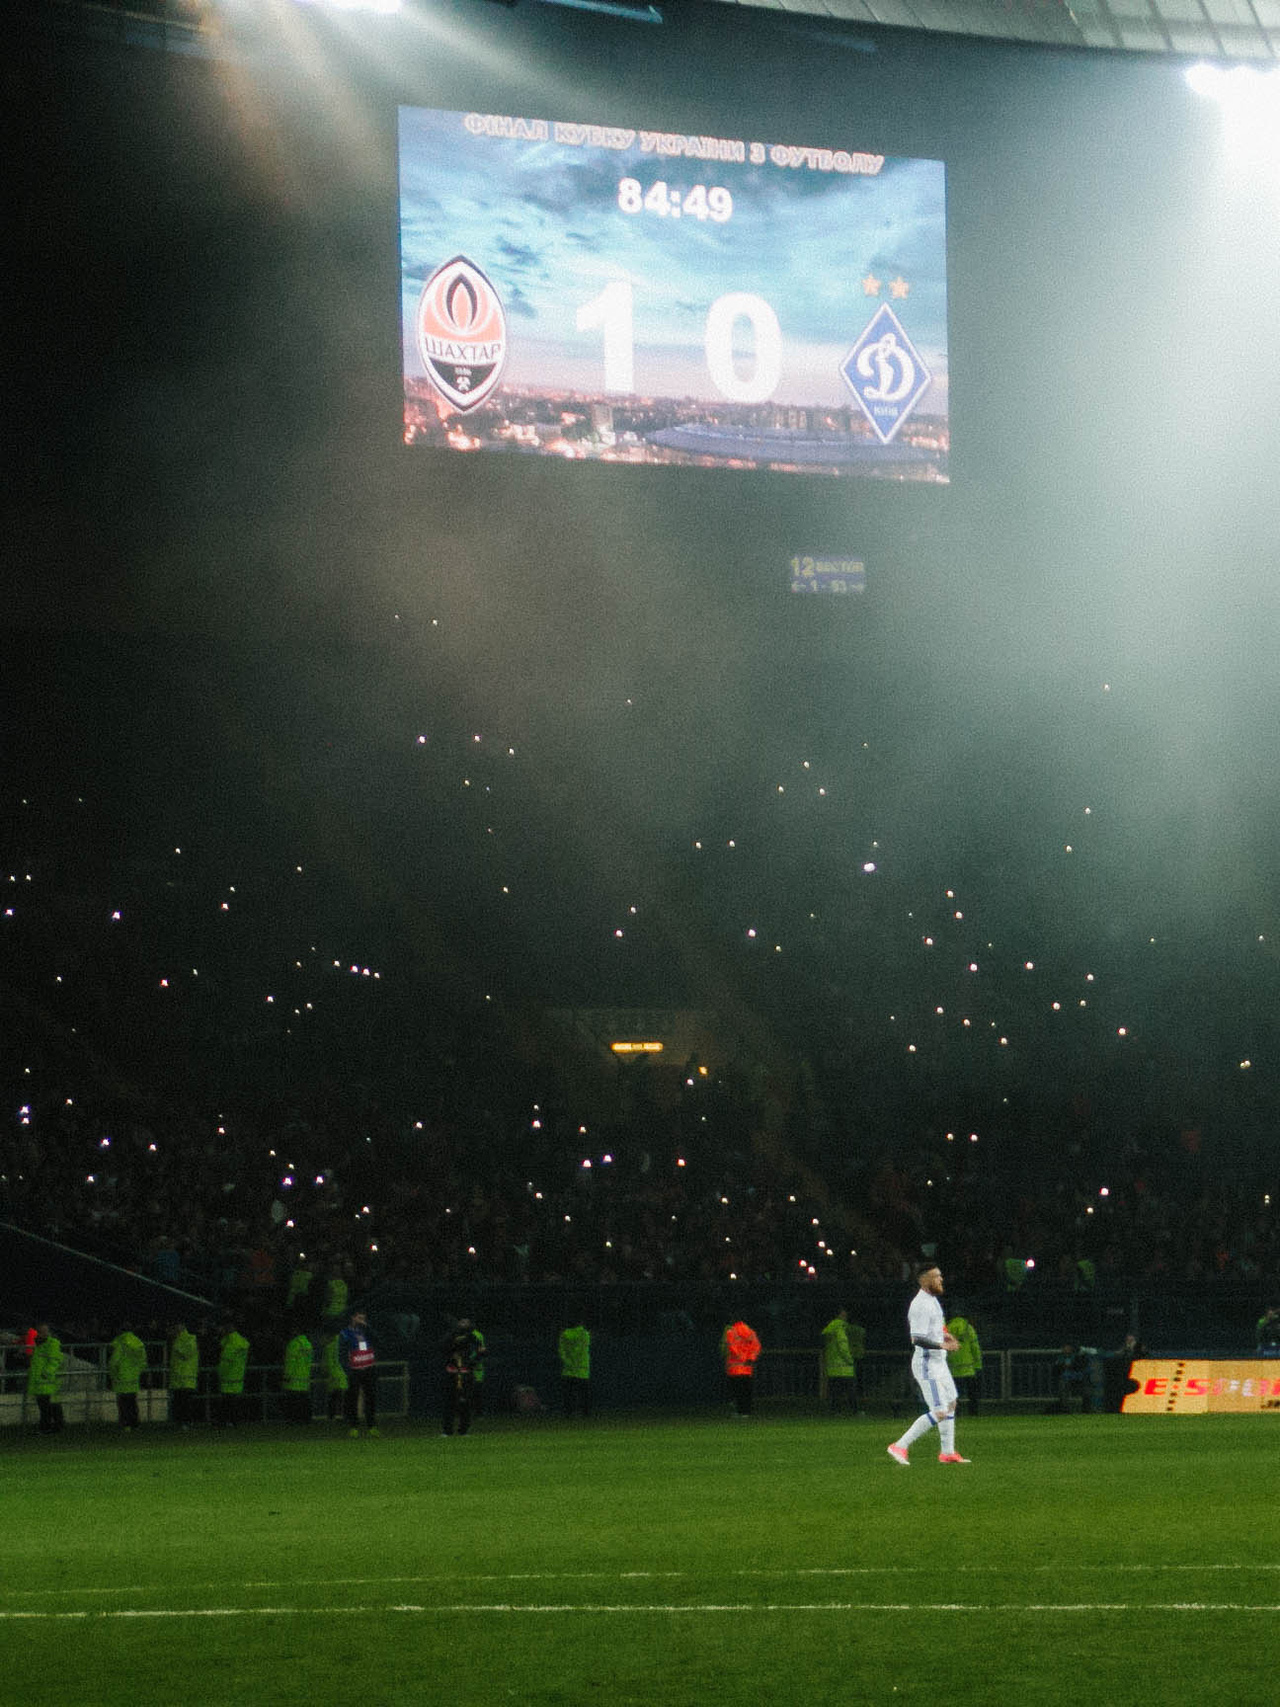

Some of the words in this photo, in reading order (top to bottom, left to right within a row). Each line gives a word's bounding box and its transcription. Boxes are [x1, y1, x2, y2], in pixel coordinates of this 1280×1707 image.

[464, 113, 548, 141] ФІНАЛ
[555, 122, 636, 150] КУБКУ
[640, 131, 745, 162] УКРАЇНИ
[770, 145, 884, 175] ФУТБОЛУ
[618, 177, 733, 222] 84:49
[425, 336, 501, 361] ШАХТАР
[576, 281, 633, 391] 1
[705, 292, 783, 403] 0
